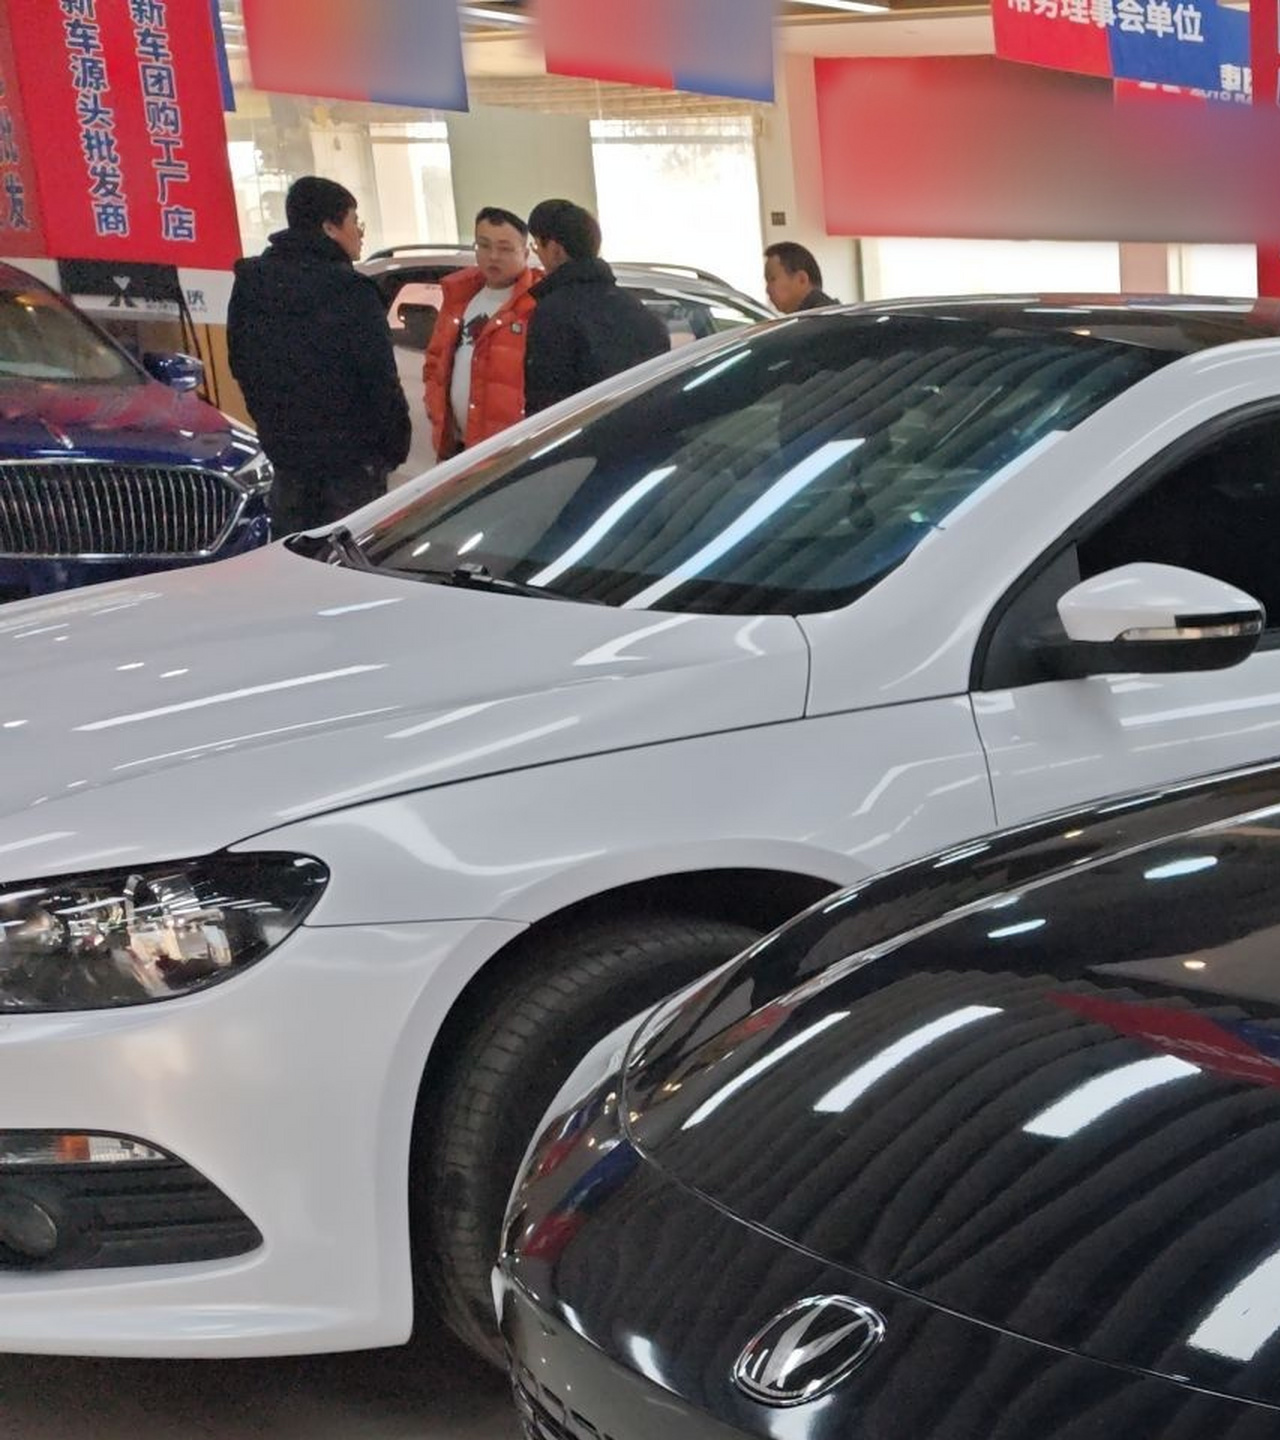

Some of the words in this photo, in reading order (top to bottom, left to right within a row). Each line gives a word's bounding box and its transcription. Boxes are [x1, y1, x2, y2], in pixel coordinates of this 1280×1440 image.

[129, 0, 195, 242] 新车团购工厂店
